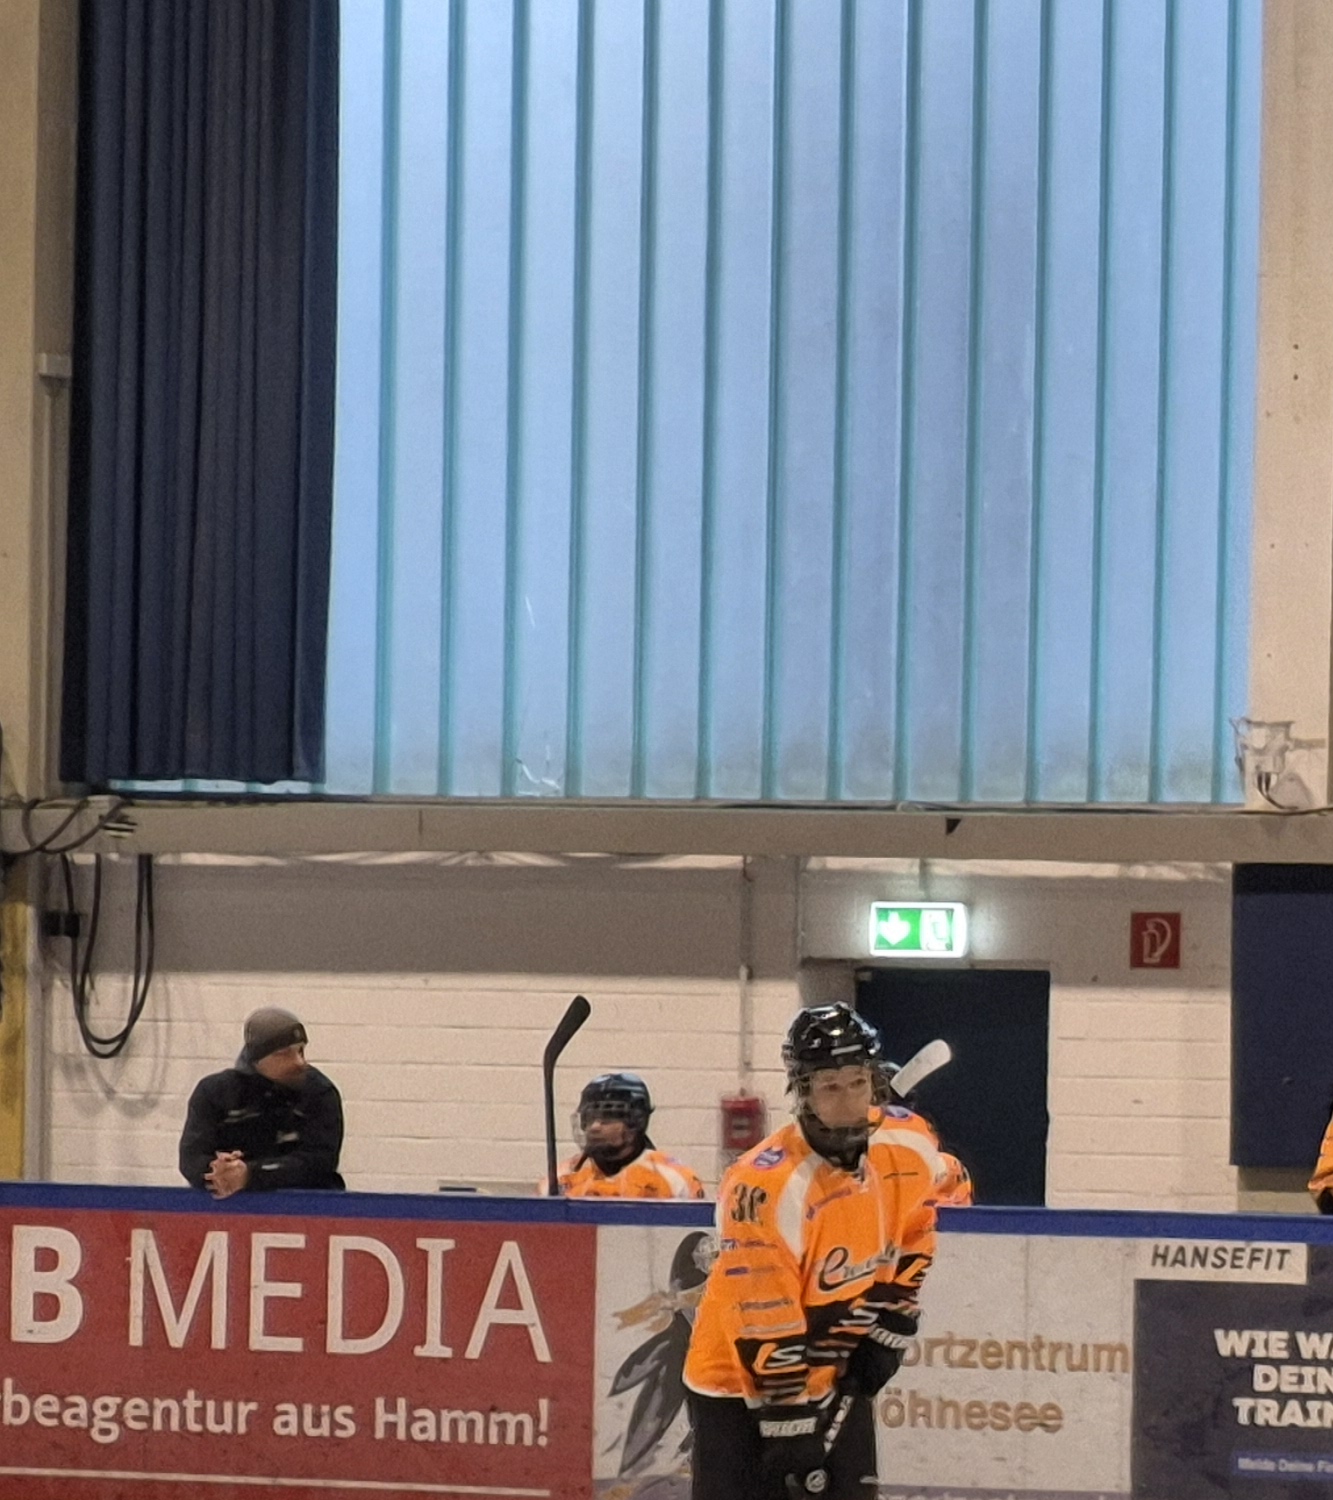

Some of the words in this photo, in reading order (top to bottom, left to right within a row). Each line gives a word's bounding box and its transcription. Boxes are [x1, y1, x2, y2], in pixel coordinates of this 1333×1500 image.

[1151, 1243, 1292, 1272] HANSEFIT
[11, 1224, 84, 1344] B
[128, 1228, 553, 1363] MEDIA
[1214, 1327, 1289, 1359] WIE
[273, 1400, 356, 1439] aus
[374, 1396, 549, 1447] Hamm!
